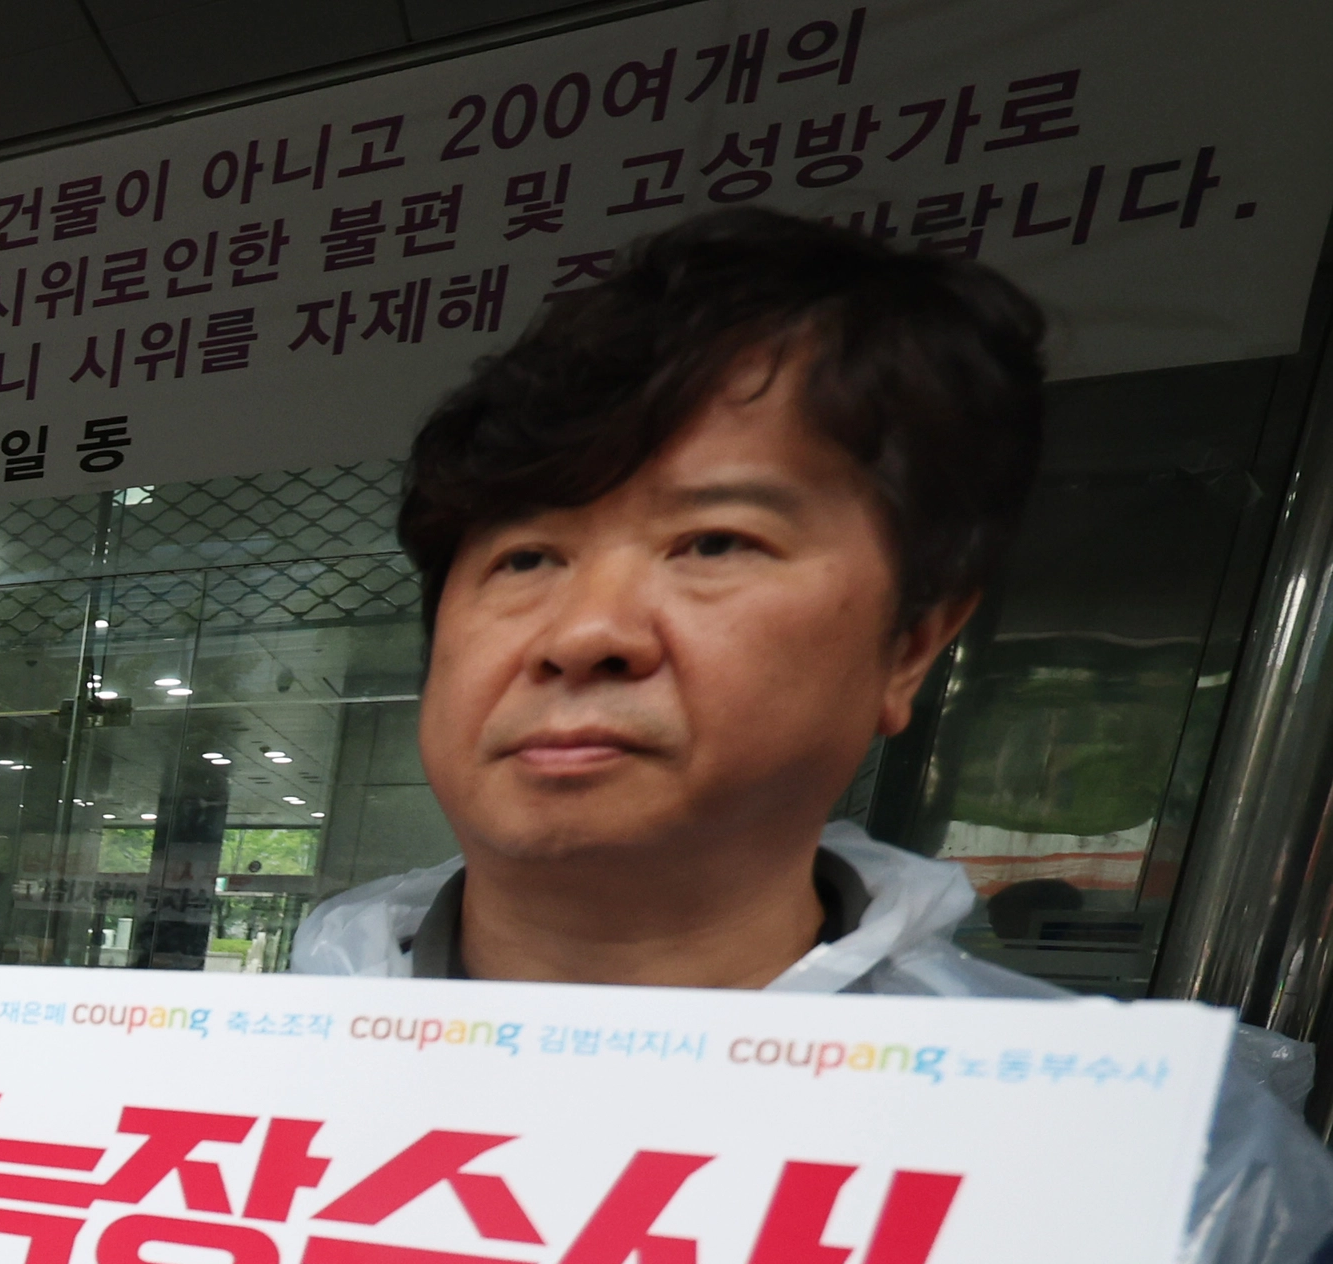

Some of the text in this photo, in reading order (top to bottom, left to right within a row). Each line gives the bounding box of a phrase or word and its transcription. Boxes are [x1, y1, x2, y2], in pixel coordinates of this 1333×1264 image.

[200, 114, 406, 204] 아니고
[441, 6, 866, 161] 200여개의
[319, 184, 463, 272] 불편
[503, 164, 572, 241] 및
[606, 69, 1082, 217] 고성방가로
[69, 306, 259, 389] 시위를
[288, 264, 511, 355] 자제해
[71, 1001, 211, 1038] coupang
[225, 1009, 334, 1041] 축소조작
[350, 1011, 524, 1055] coupang
[538, 1023, 708, 1063] 김범석지시
[728, 1032, 948, 1083] coupang
[955, 1047, 1170, 1089] 노동부수사
